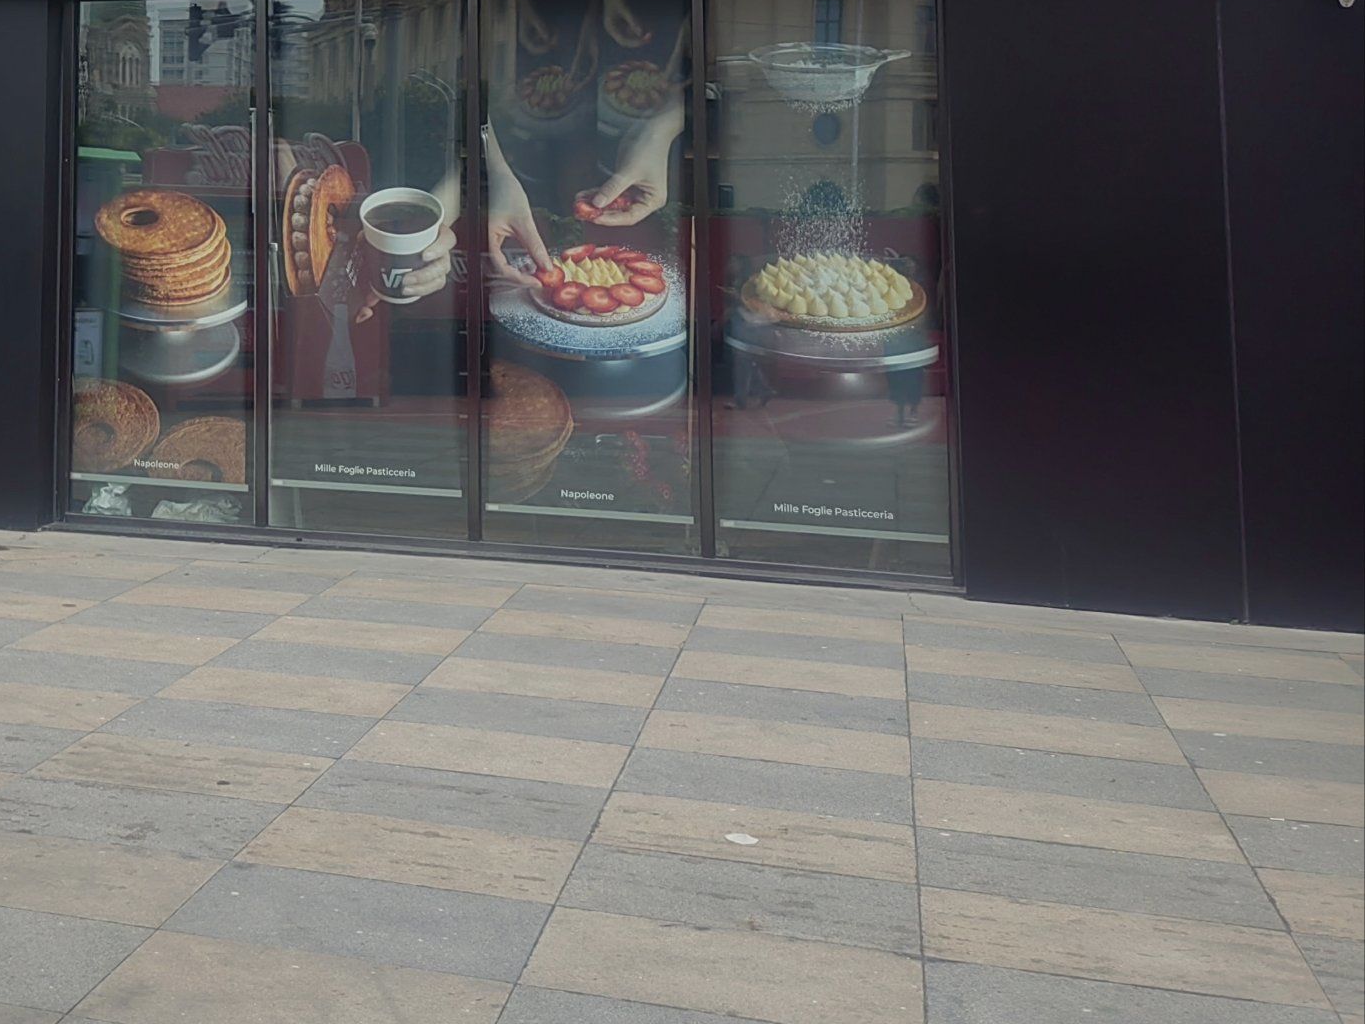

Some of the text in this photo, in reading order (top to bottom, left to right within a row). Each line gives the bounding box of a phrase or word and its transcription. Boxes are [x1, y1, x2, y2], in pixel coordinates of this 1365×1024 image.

[134, 457, 180, 471] Napoleone
[315, 463, 416, 478] Mille Foglie Pasticceria
[560, 488, 615, 502] Napoleone
[774, 503, 894, 520] Mille Foglie Pasticceria
